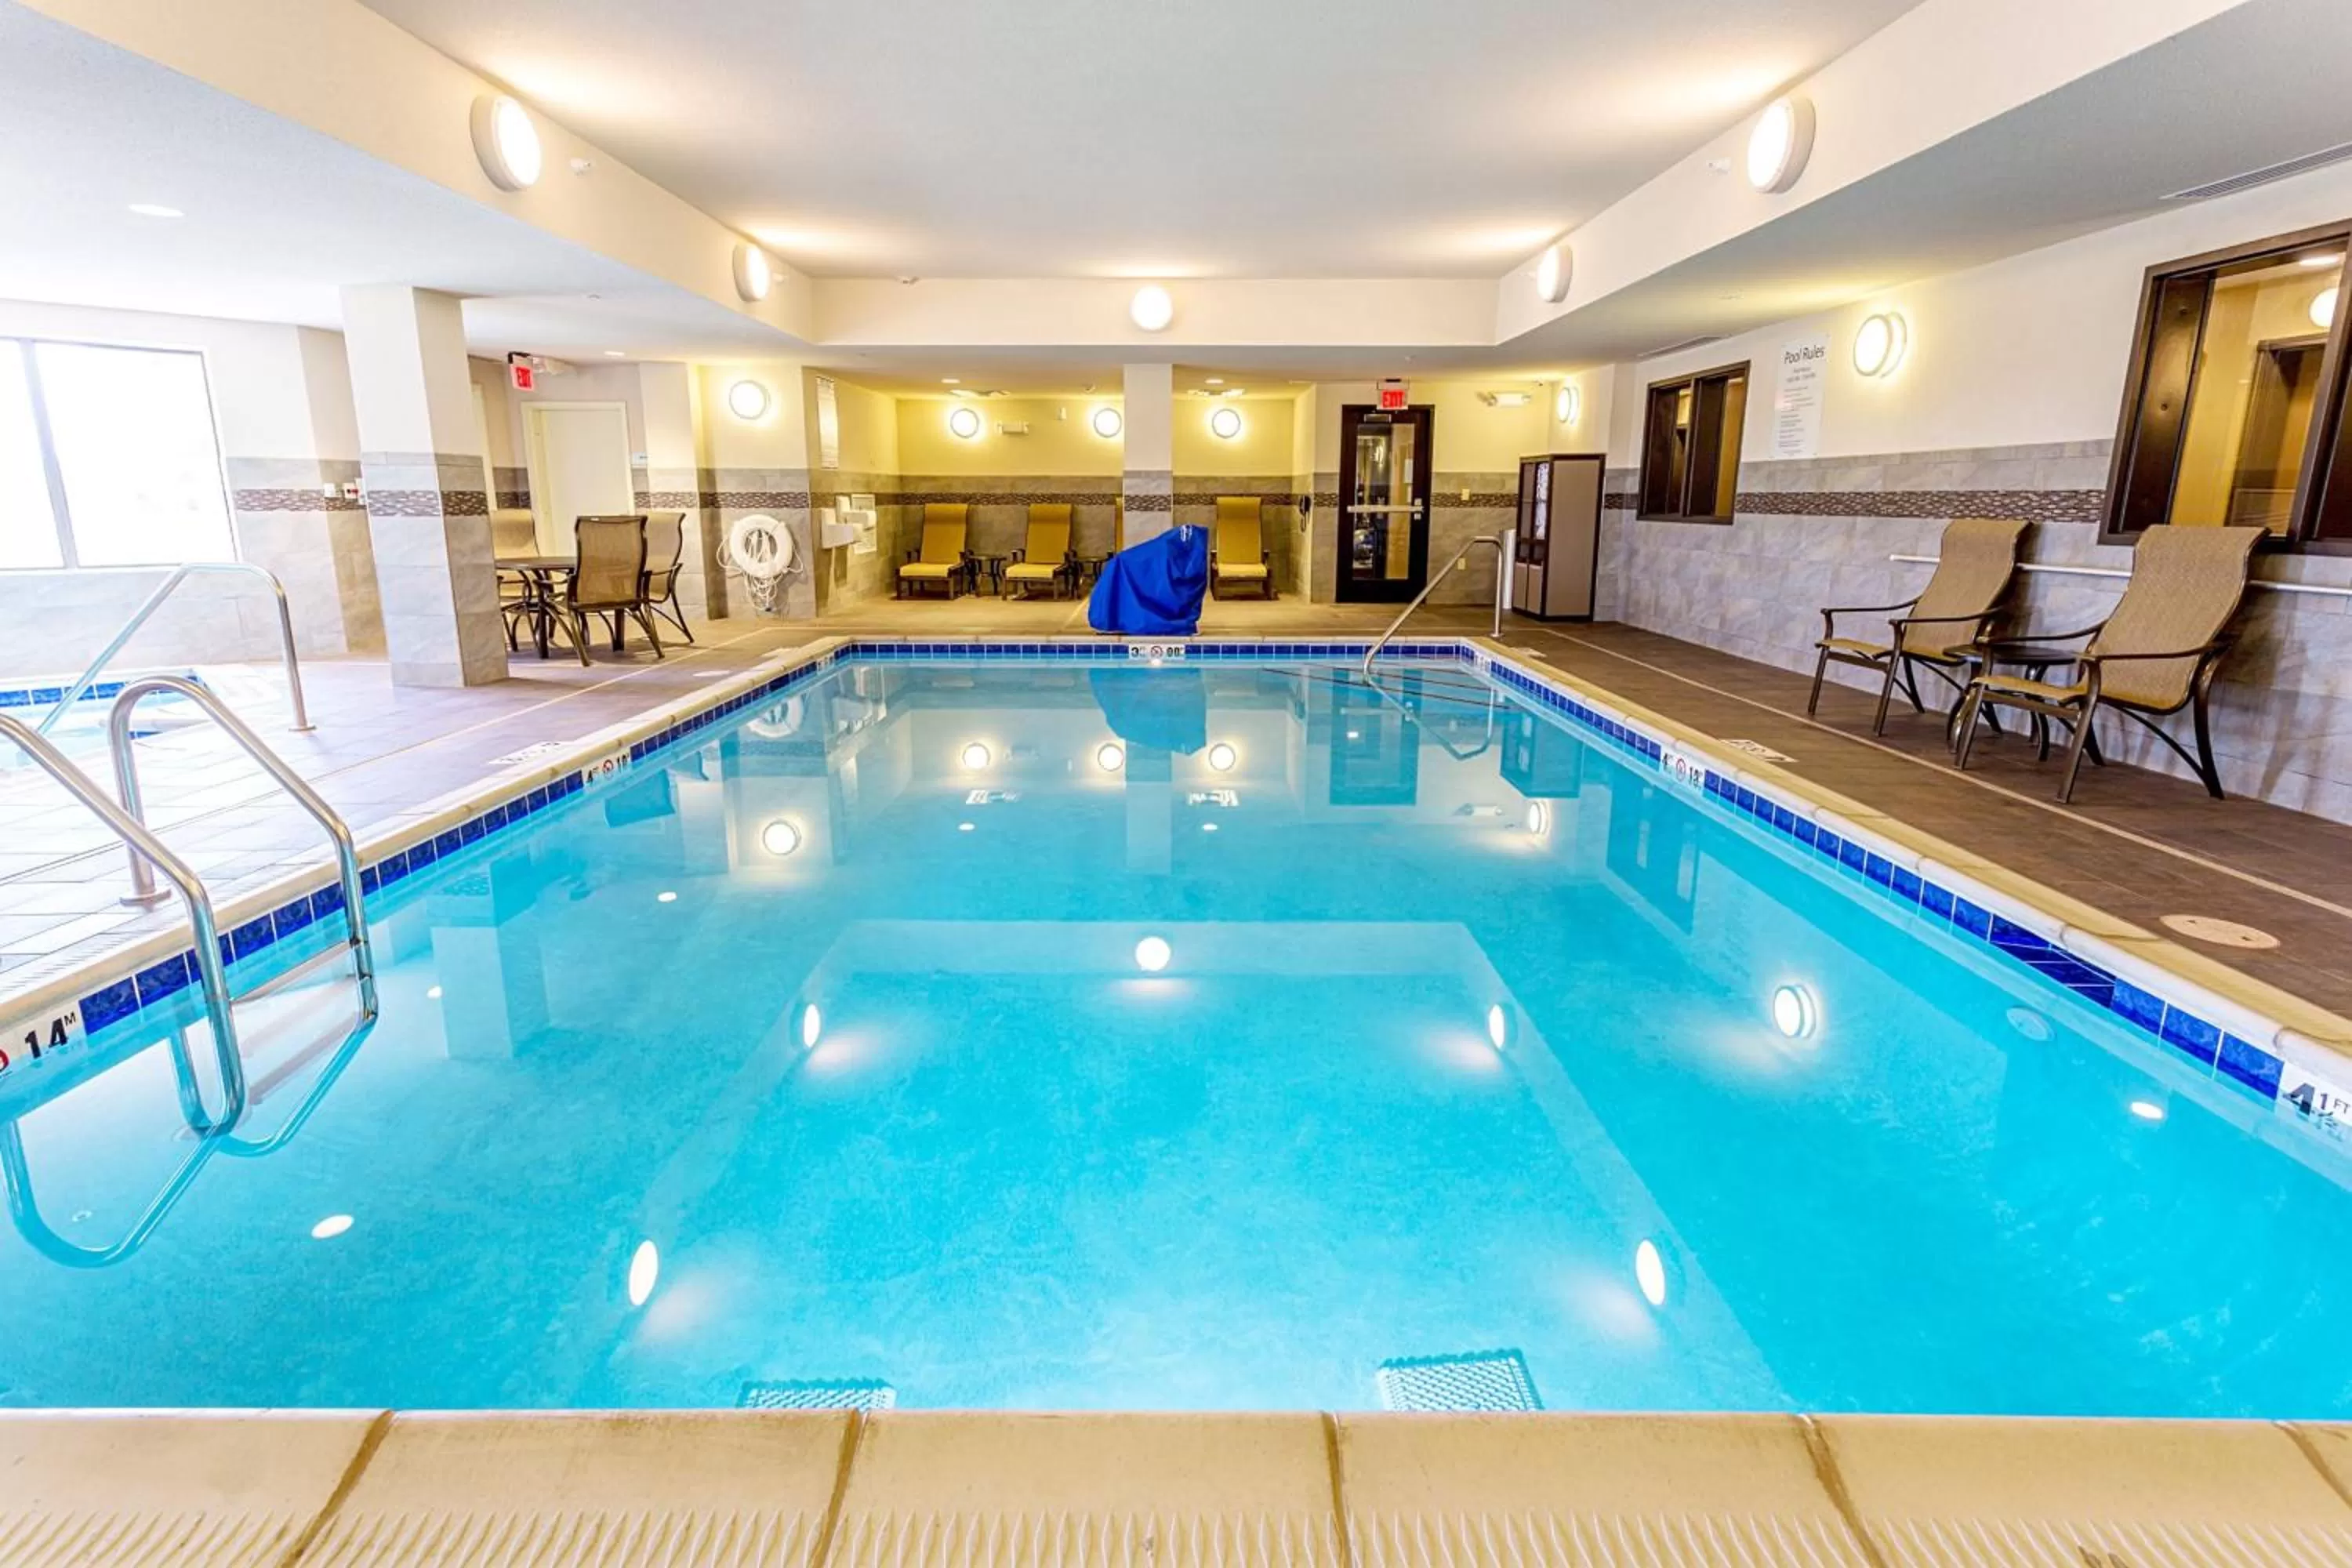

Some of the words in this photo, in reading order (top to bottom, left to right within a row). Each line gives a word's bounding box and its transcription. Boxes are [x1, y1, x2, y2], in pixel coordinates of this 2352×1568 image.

[1784, 348, 1802, 364] Pool
[1802, 345, 1825, 360] Rules
[1382, 391, 1403, 408] EXIT
